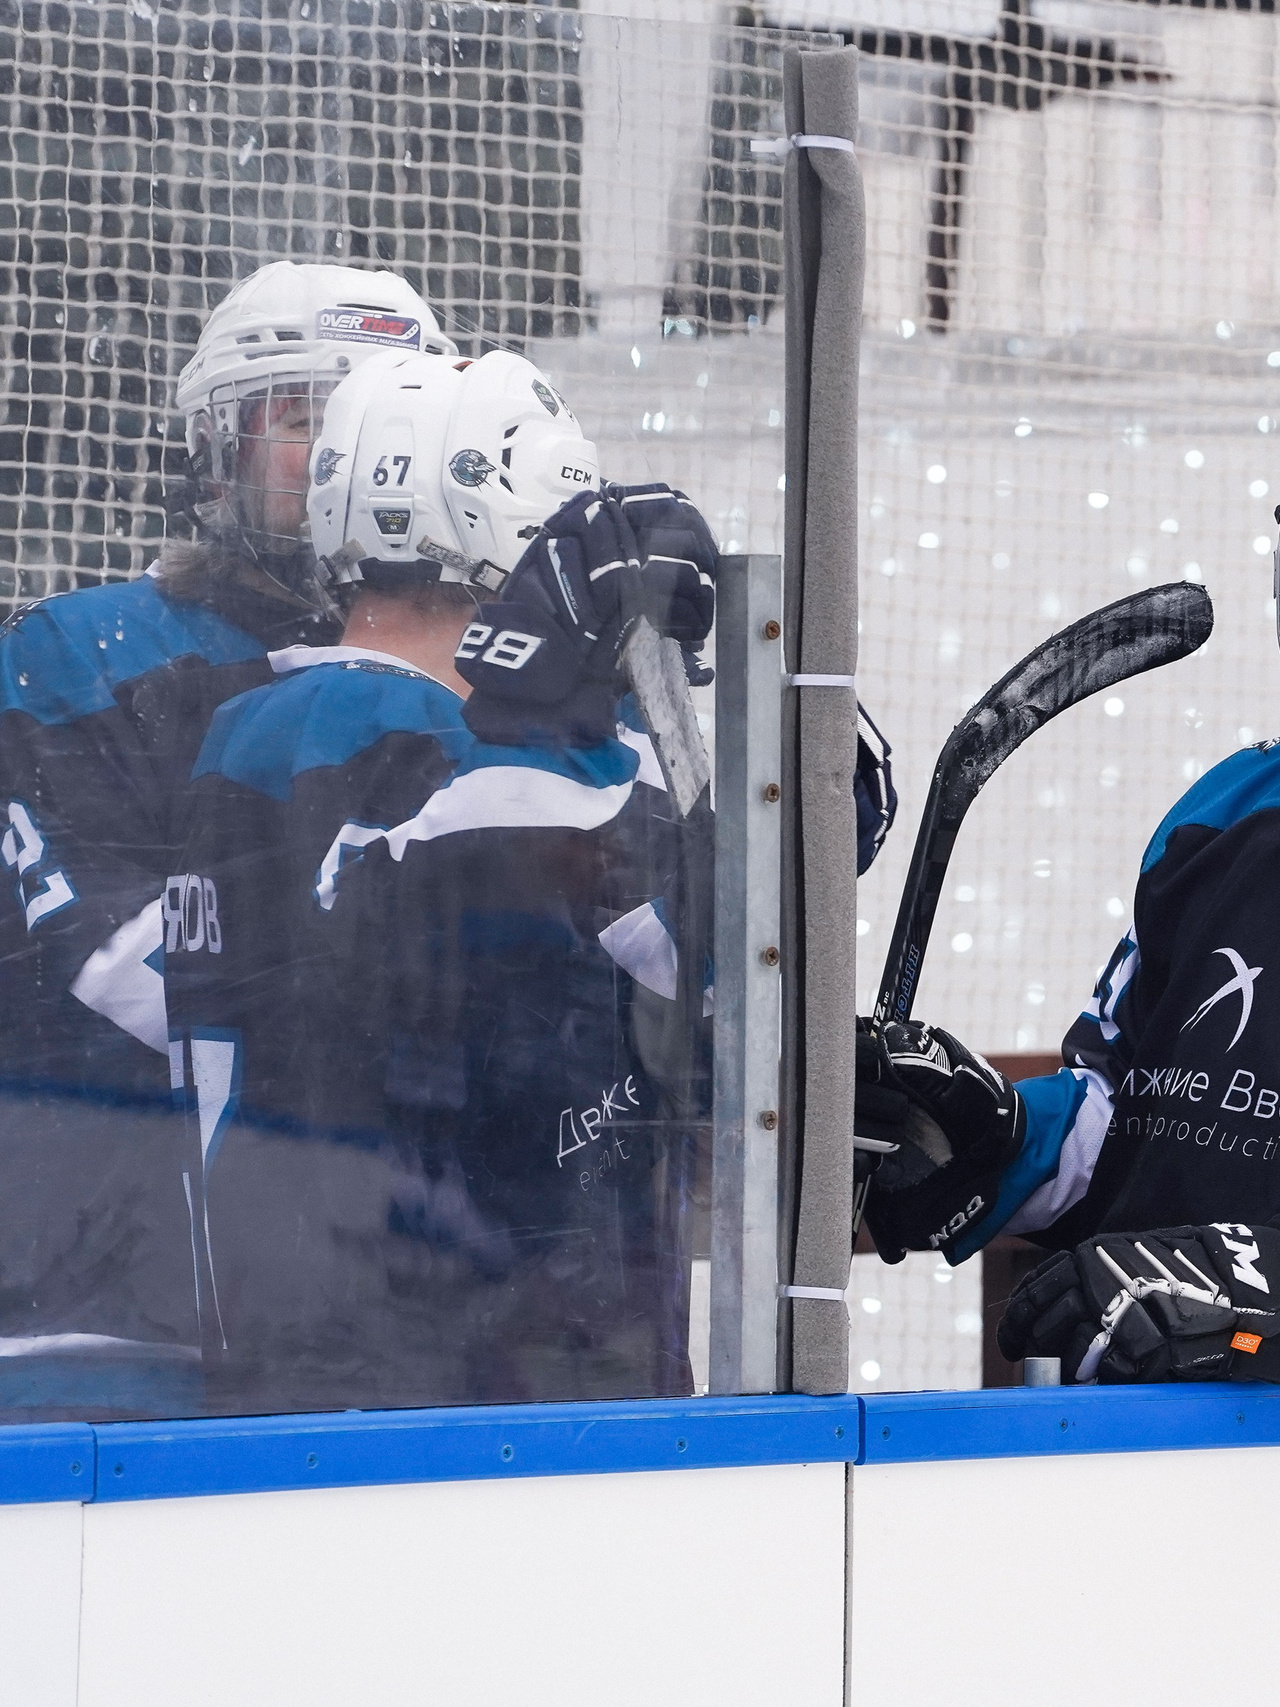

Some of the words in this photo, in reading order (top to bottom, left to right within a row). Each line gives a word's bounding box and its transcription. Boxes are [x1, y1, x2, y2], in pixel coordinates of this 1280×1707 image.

[320, 313, 406, 336] OVERTIME
[373, 455, 412, 487] 67
[560, 465, 593, 485] CCM
